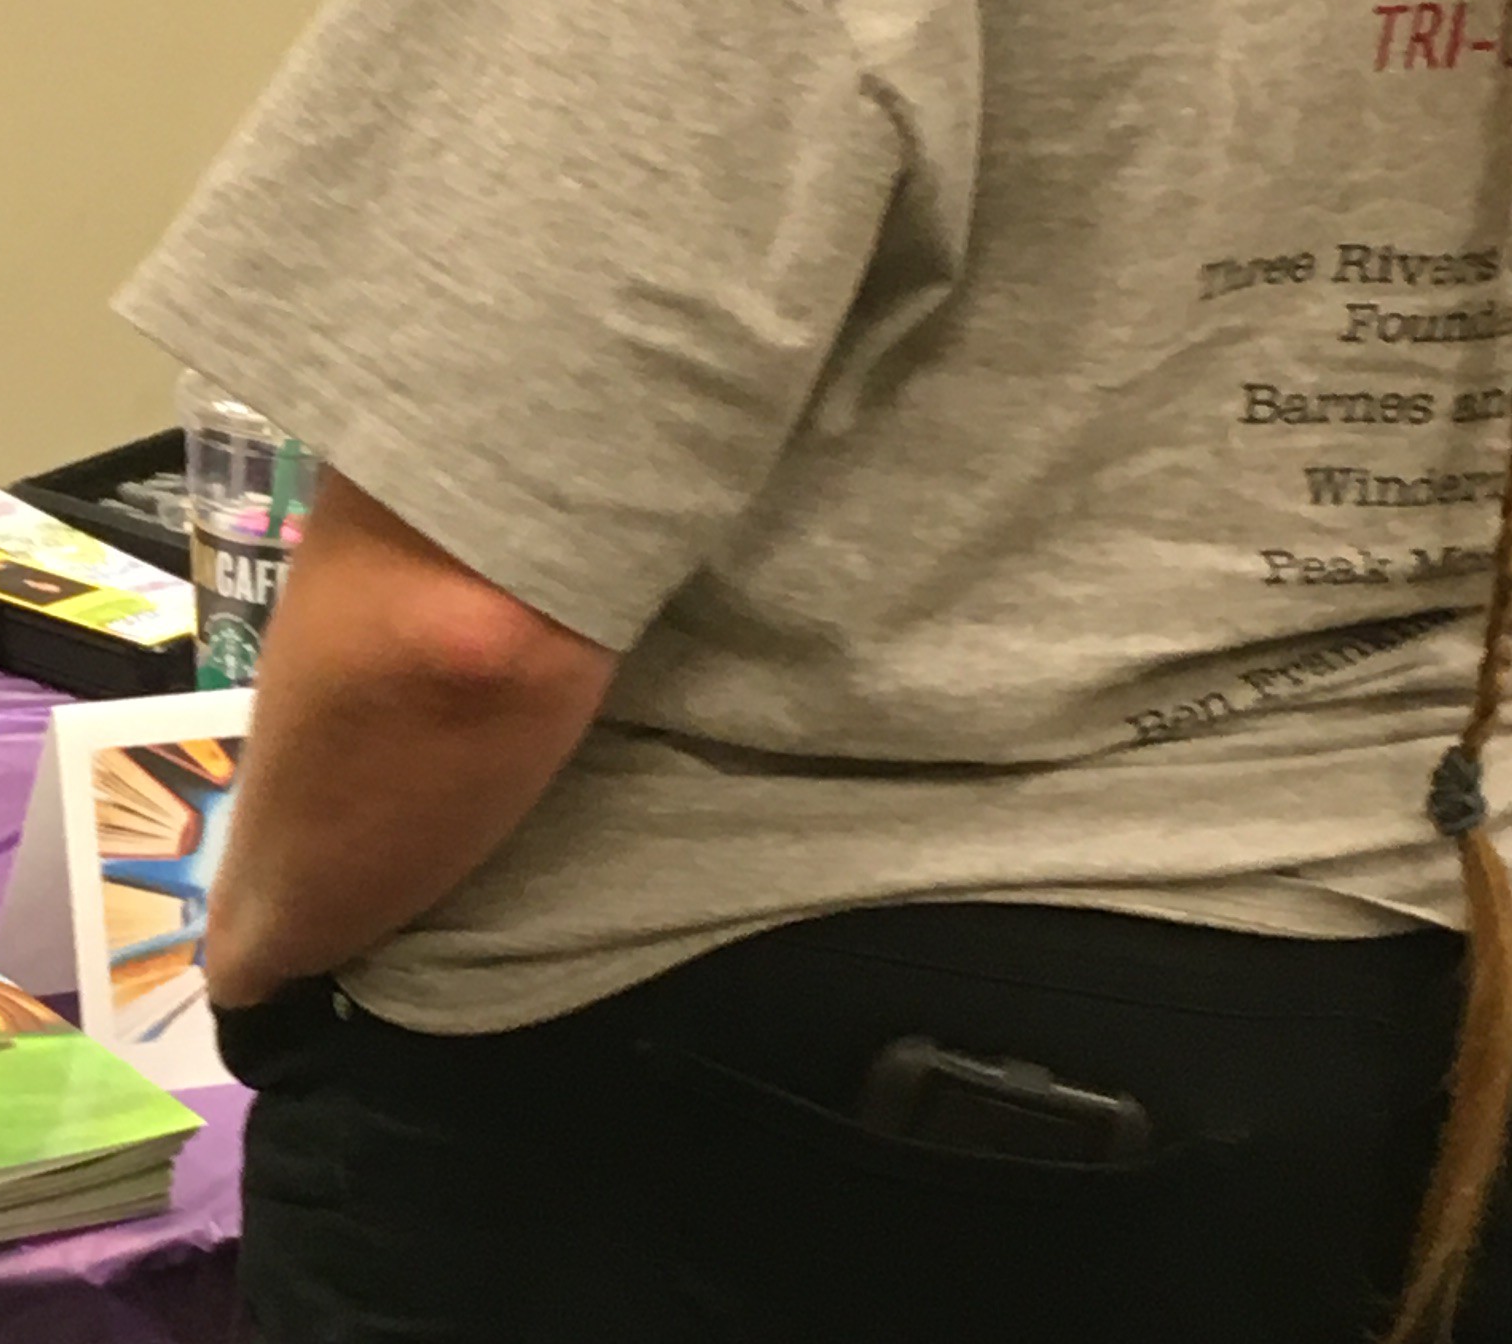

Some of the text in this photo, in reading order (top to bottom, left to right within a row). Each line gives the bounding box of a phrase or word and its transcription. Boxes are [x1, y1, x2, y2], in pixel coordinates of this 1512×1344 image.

[1372, 2, 1512, 74] TRI-
[1239, 382, 1435, 424] Barnes
[1259, 548, 1392, 585] Peak
[1124, 690, 1235, 743] Ben
